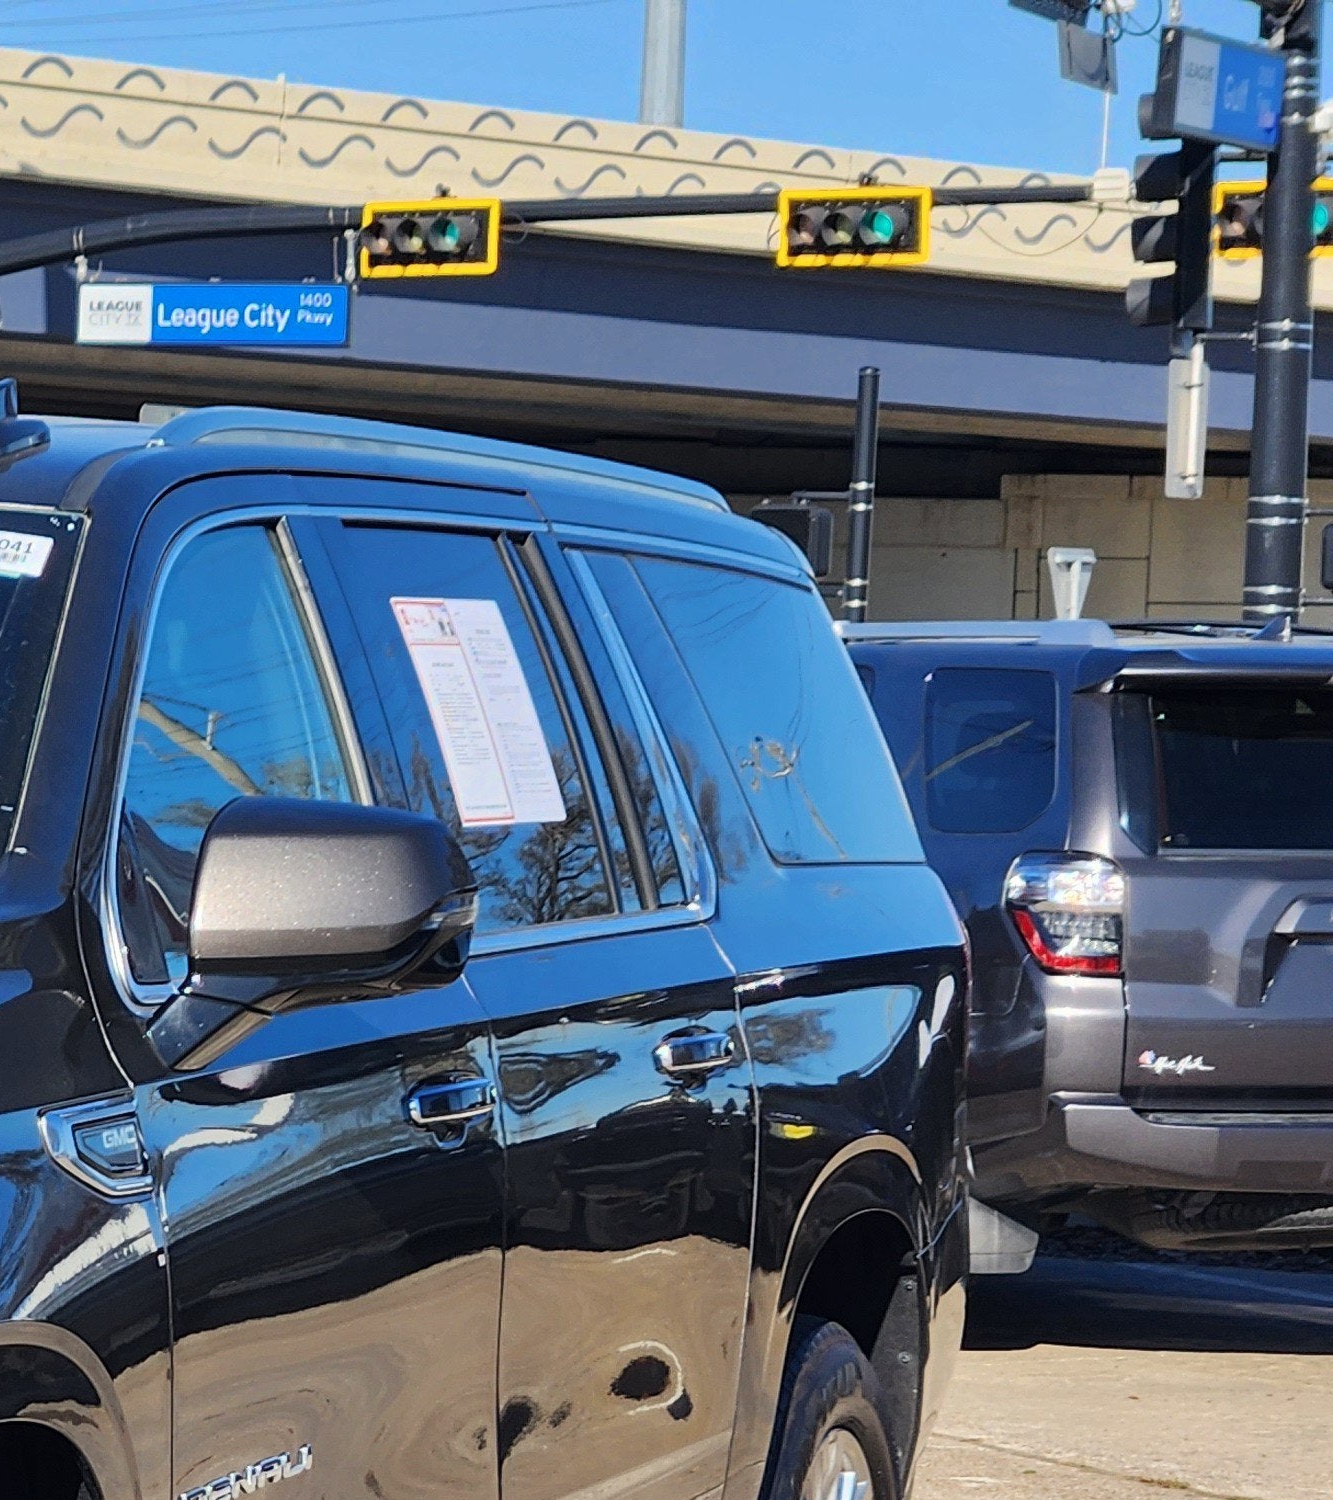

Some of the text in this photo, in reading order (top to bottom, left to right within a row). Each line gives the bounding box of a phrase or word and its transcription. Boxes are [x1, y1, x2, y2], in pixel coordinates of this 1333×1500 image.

[89, 300, 142, 312] LEAGUE
[89, 314, 124, 327] CITY
[156, 302, 291, 334] League City
[296, 309, 333, 326] Pkwy
[102, 1124, 137, 1149] GMC
